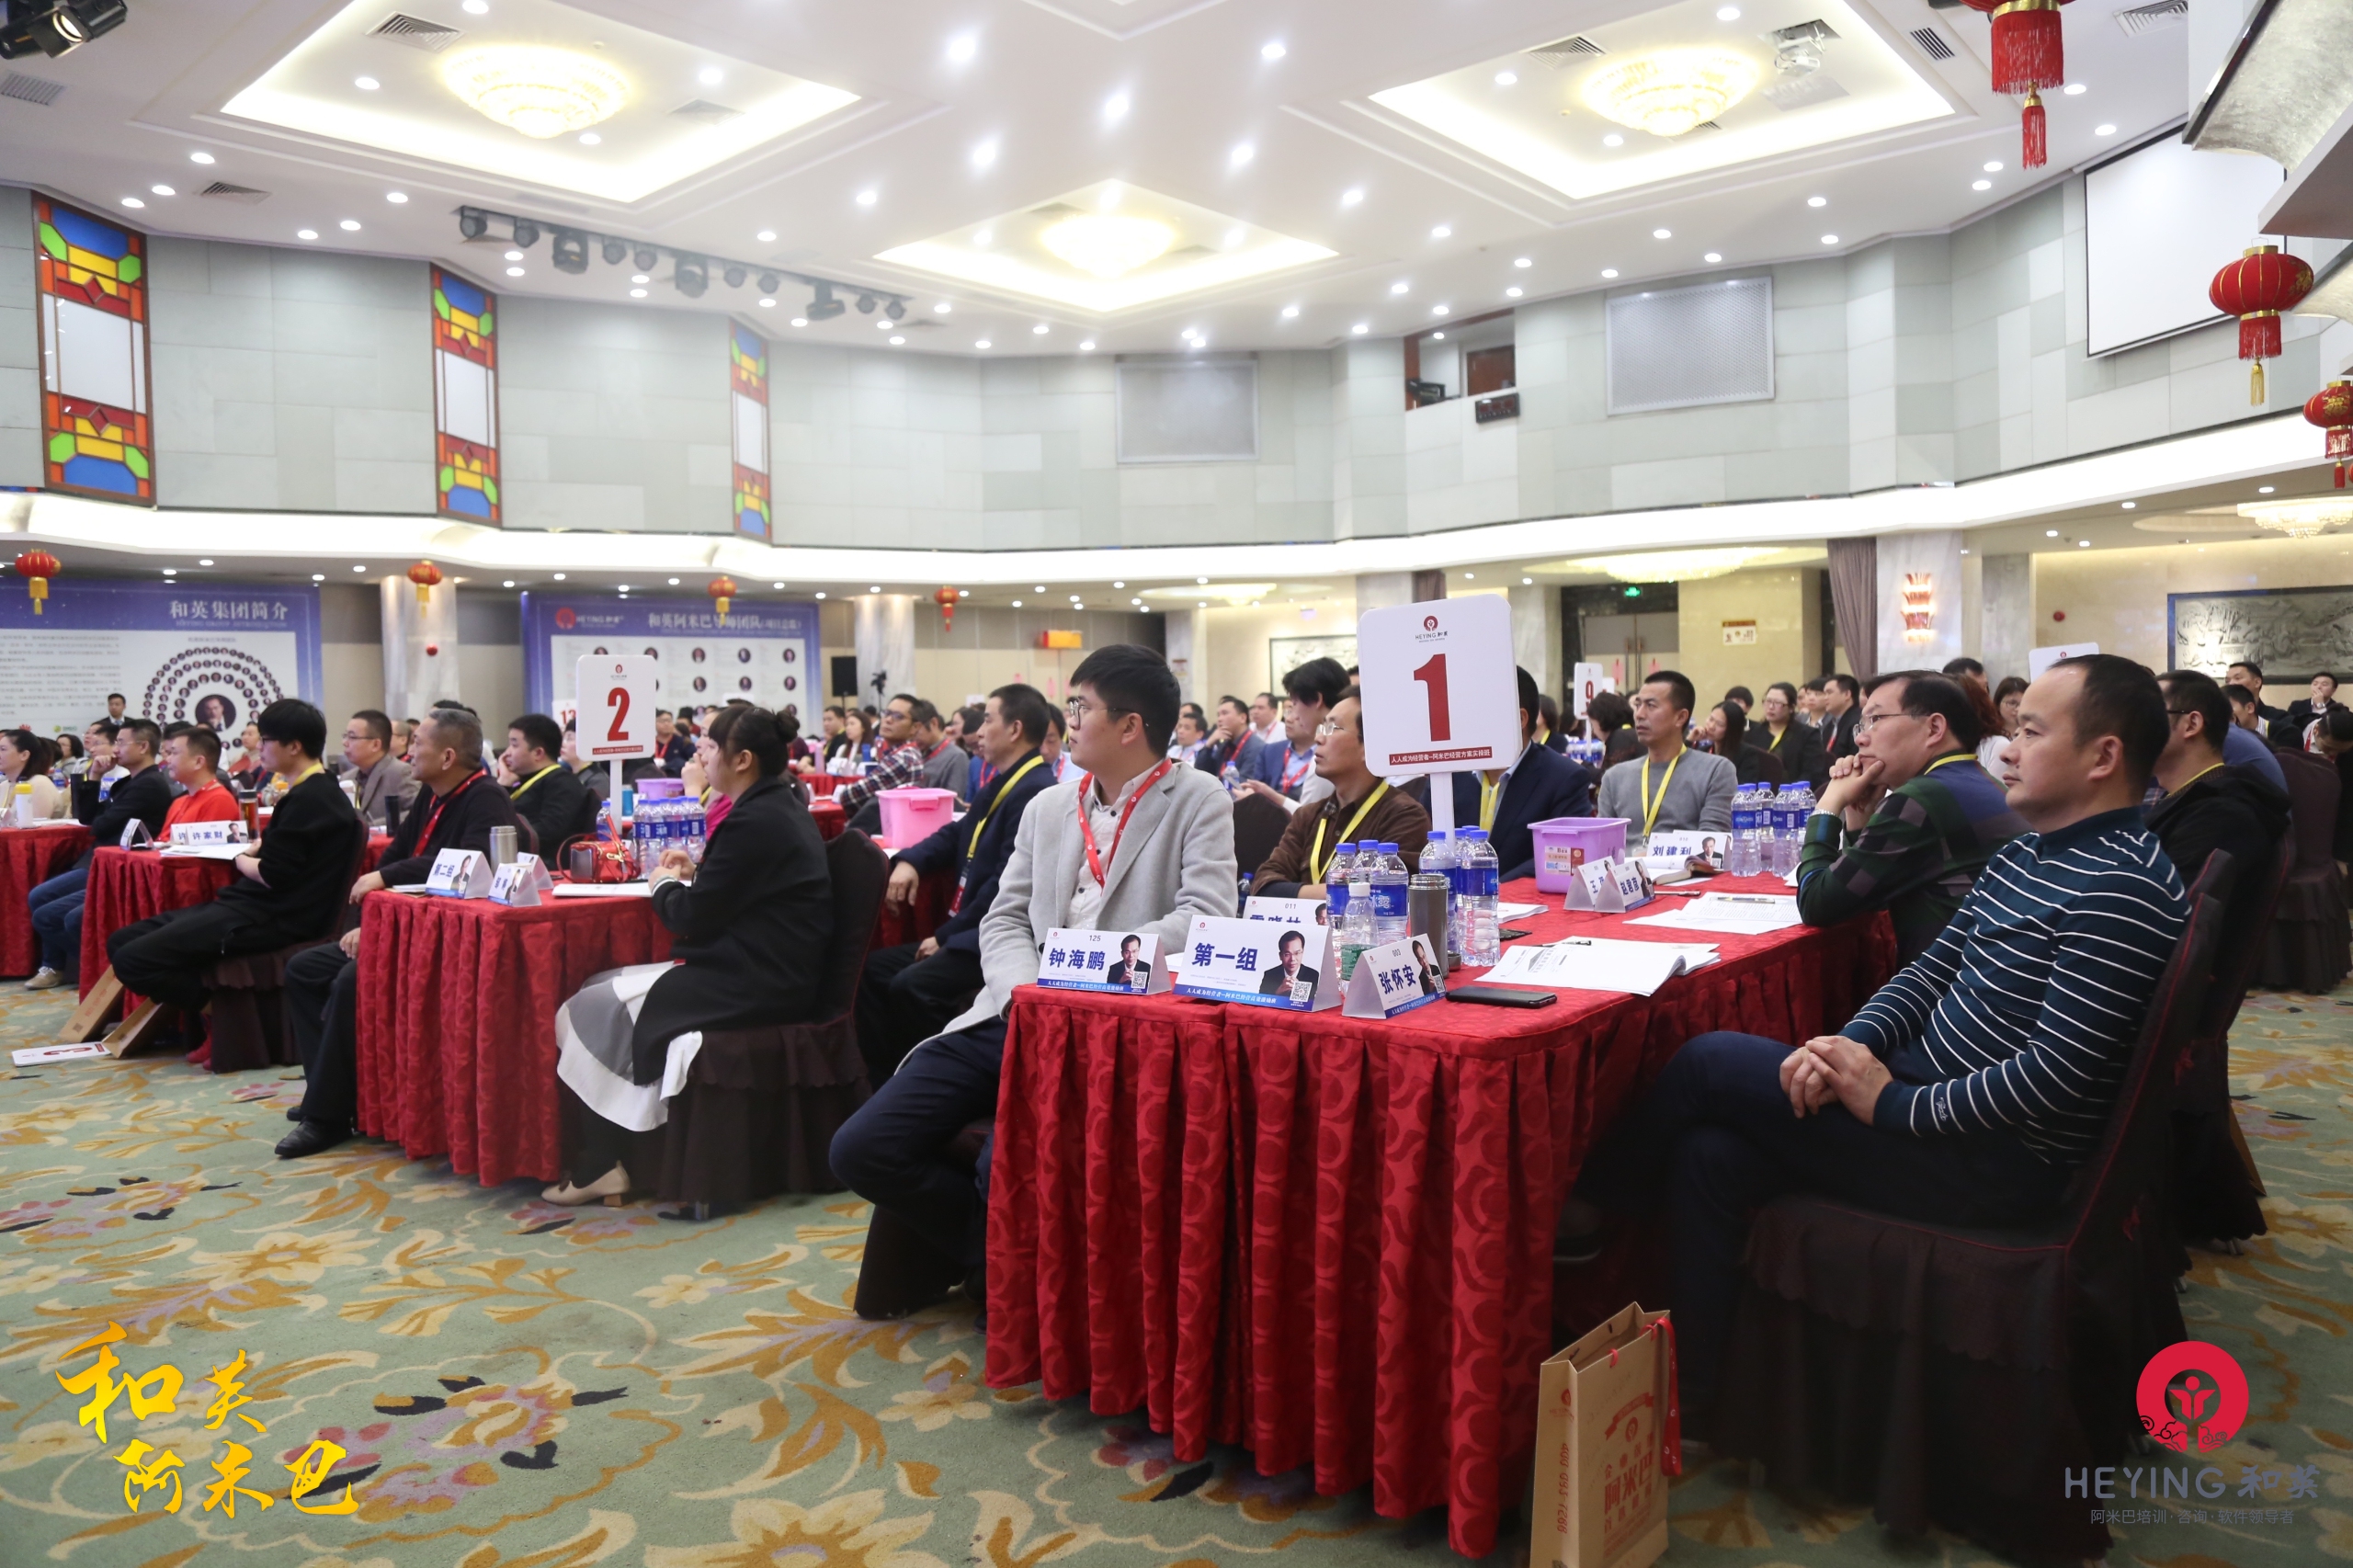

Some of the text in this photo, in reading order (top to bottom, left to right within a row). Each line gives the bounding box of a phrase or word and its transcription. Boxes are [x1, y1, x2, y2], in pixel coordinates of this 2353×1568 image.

[170, 600, 289, 620] 和英集团简介
[1414, 653, 1450, 742] 1
[608, 687, 630, 742] 2
[1049, 948, 1106, 971] 钟海鹏
[1192, 942, 1258, 972] 第一组
[1379, 964, 1416, 994] 张怀安
[1605, 1450, 1653, 1515] 阿米巴
